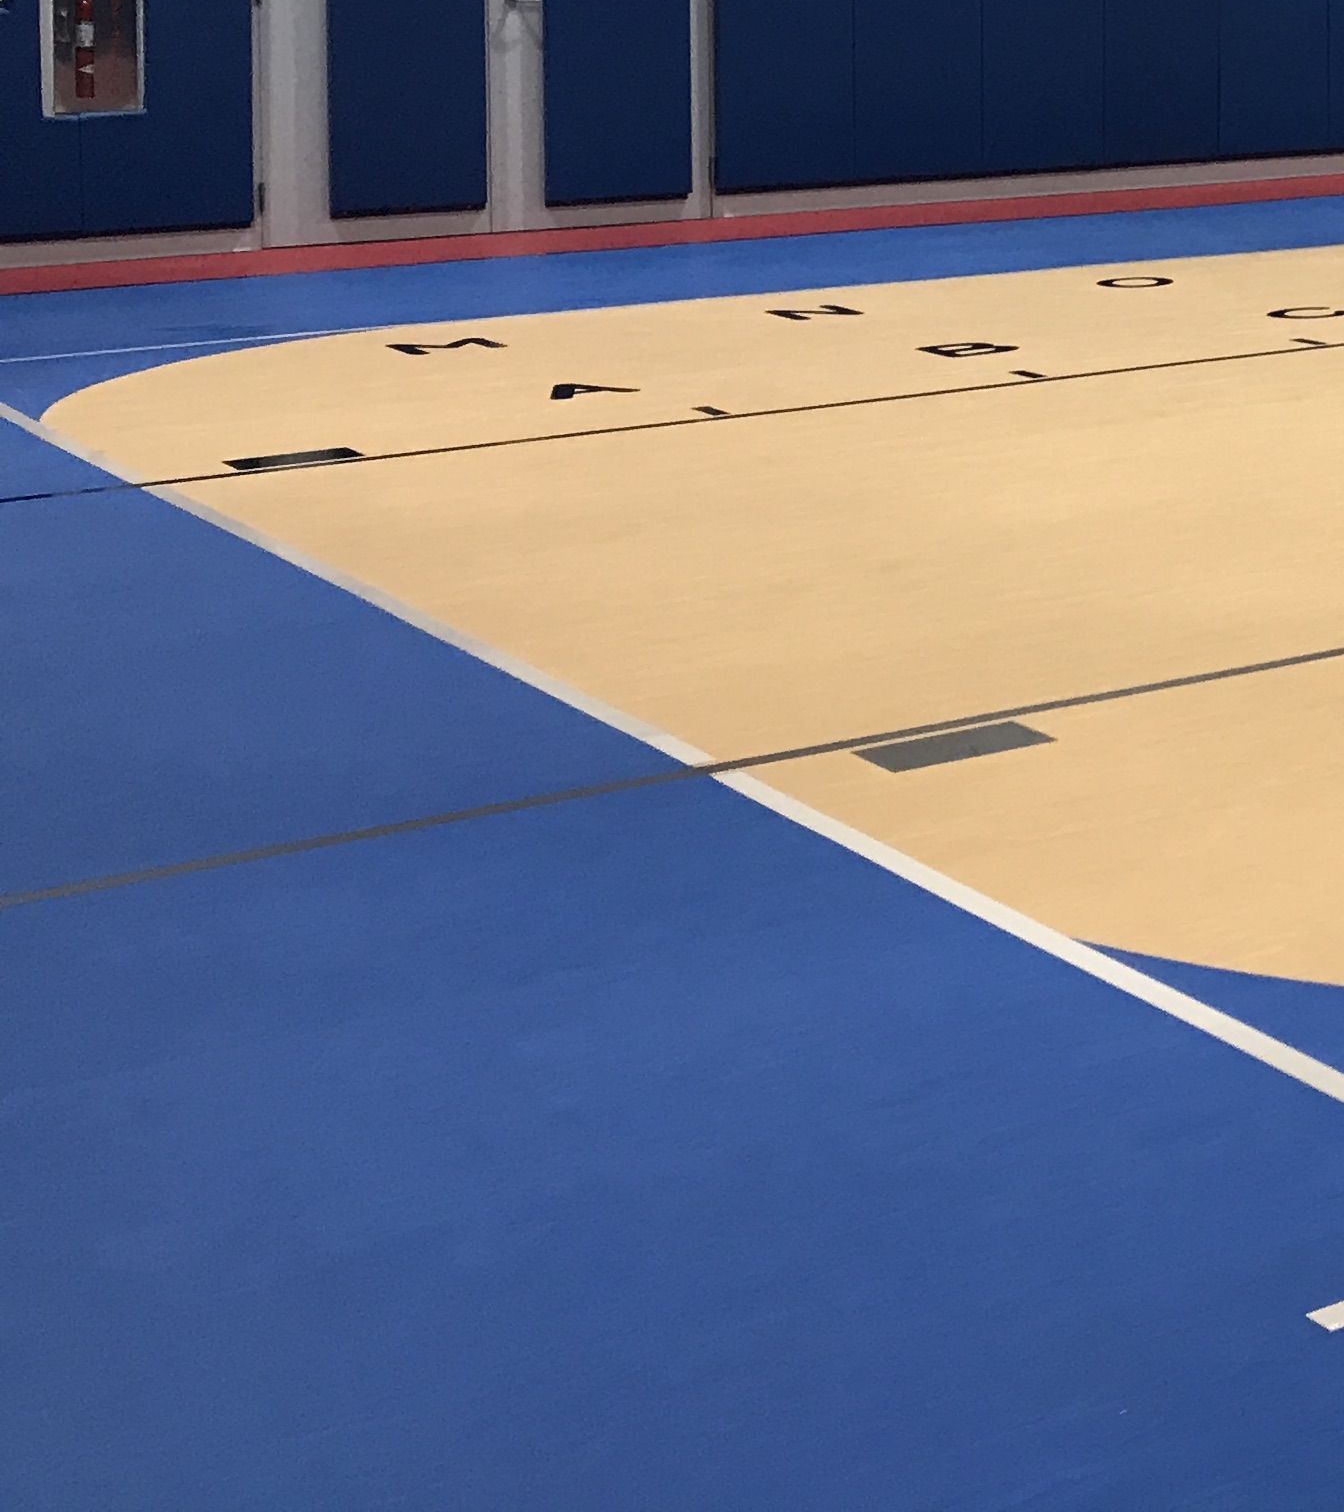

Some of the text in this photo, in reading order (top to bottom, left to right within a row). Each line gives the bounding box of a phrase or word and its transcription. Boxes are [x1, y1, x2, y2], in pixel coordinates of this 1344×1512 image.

[1095, 276, 1174, 289] O
[386, 336, 507, 355] M
[914, 342, 1020, 359] B
[549, 382, 641, 401] A
